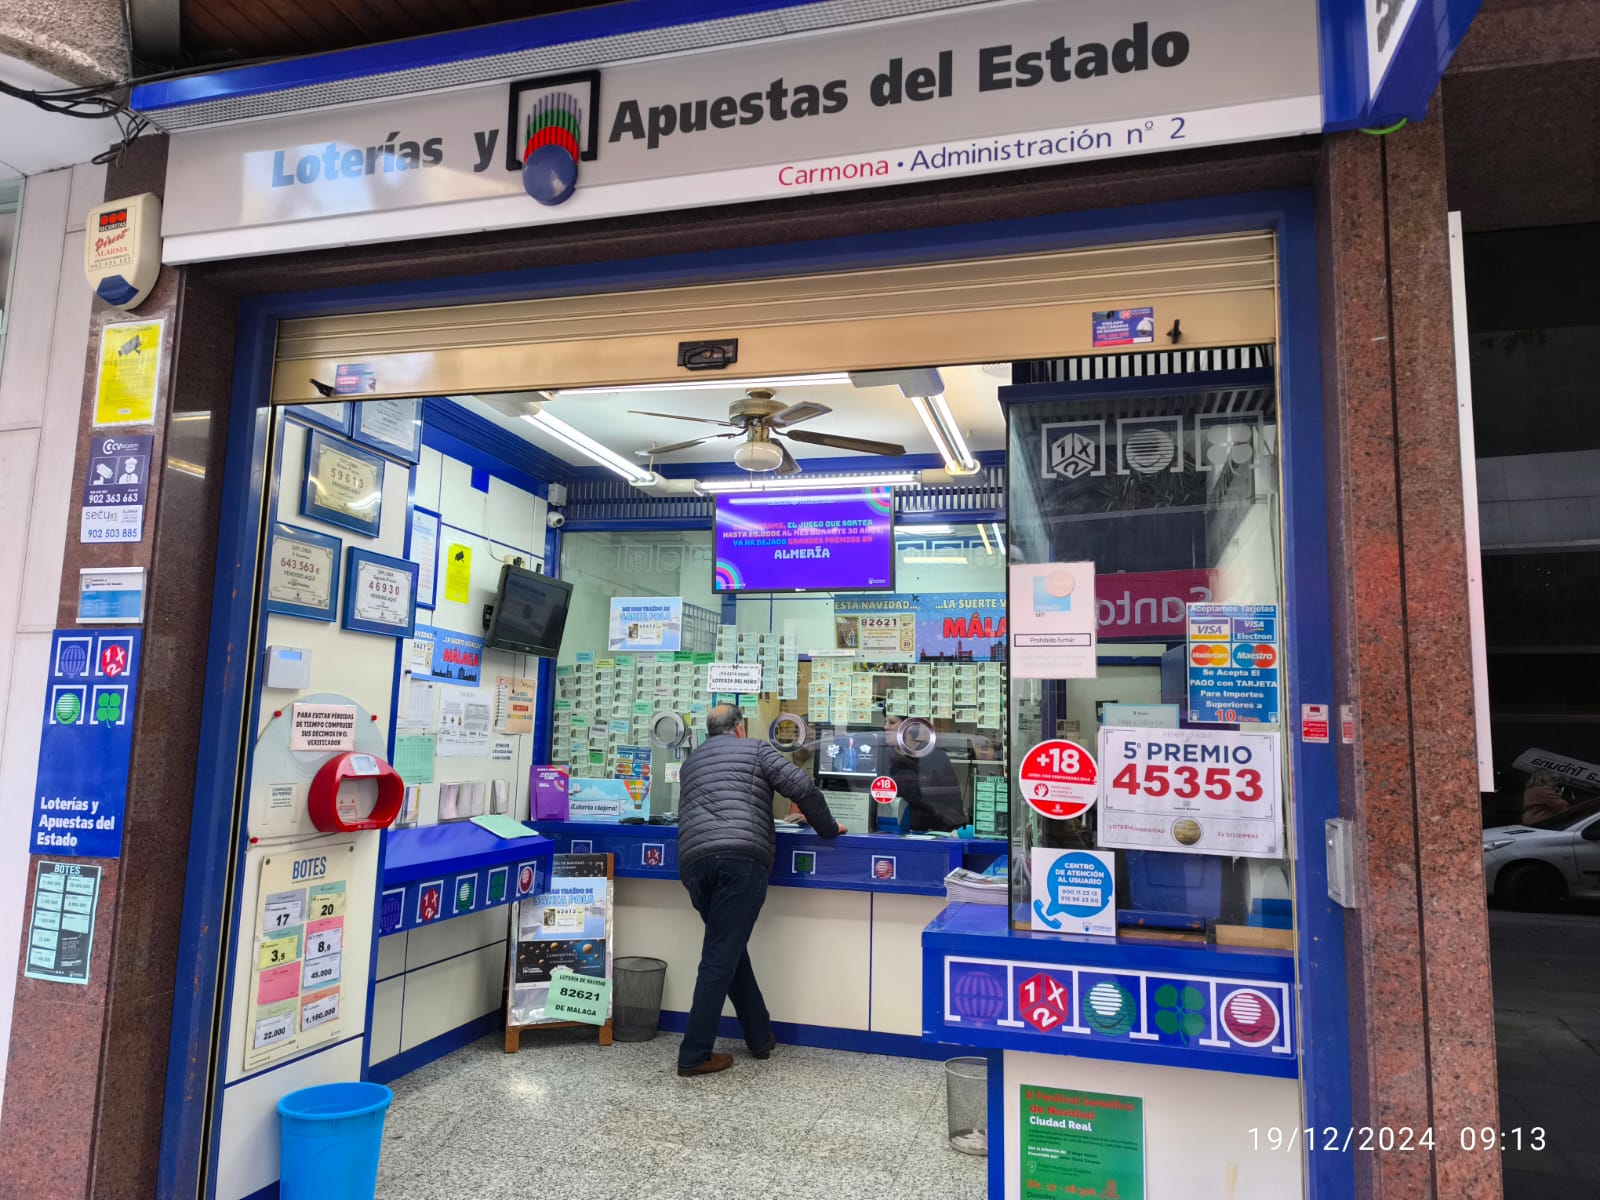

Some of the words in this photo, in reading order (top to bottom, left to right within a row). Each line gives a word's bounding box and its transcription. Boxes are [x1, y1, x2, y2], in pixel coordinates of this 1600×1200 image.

[272, 131, 443, 188] Loterías
[473, 129, 499, 173] y
[609, 77, 849, 149] Apuestas
[870, 50, 953, 108] del
[980, 21, 1190, 93] Estado
[778, 157, 890, 187] Carmona
[911, 127, 1112, 173] Administración
[1170, 117, 1187, 140] 2
[89, 494, 104, 504] 902
[106, 494, 121, 503] 363
[123, 493, 138, 503] 663
[88, 529, 103, 539] 902
[105, 529, 119, 538] 503
[122, 528, 137, 538] 885
[774, 546, 830, 560] ALMERÍA
[281, 557, 315, 574] 643.563
[369, 582, 400, 596] 46930
[835, 601, 859, 610] ESTA
[862, 600, 919, 610] NAVIDAD...
[936, 600, 955, 609] ...LA
[959, 599, 997, 609] SUERTE
[1190, 605, 1237, 613] Aceptamos
[1241, 605, 1274, 614] Tarjetas
[861, 618, 897, 626] 82621
[1197, 625, 1222, 634] VISA
[443, 646, 480, 667] MÁLAGA
[1237, 652, 1273, 660] Maestro
[1217, 669, 1249, 677] Acepta
[1223, 690, 1264, 699] Importes
[1206, 701, 1254, 709] Superiores
[297, 711, 312, 719] PARA
[1215, 709, 1236, 722] 10
[1148, 742, 1252, 765] PREMIO
[1037, 748, 1080, 774] +18
[877, 779, 891, 788] +18
[1112, 763, 1263, 802] 45353
[41, 796, 89, 811] Loterías
[91, 799, 99, 813] y
[570, 802, 594, 811] ¡Lotería
[594, 804, 617, 812] viajera!
[39, 815, 94, 831] Apuestas
[96, 815, 115, 830] del
[37, 832, 78, 847] Estado
[54, 864, 81, 875] BOTES
[292, 856, 327, 880] BOTES
[1067, 869, 1104, 878] ATENCIÓN
[1069, 877, 1101, 885] USUARIO
[534, 895, 568, 905] SANTA
[569, 894, 595, 905] POLA
[321, 904, 334, 916] 20
[276, 914, 290, 926] 17
[311, 969, 332, 979] 45.000
[587, 979, 606, 987] NAVIDAD
[560, 987, 600, 1001] 82621
[263, 1027, 286, 1040] 22.000
[1036, 1091, 1081, 1105] Festival
[1030, 1104, 1044, 1114] de
[1047, 1105, 1095, 1120] Navidad
[1029, 1116, 1066, 1128] Ciudad
[1068, 1120, 1092, 1131] Real
